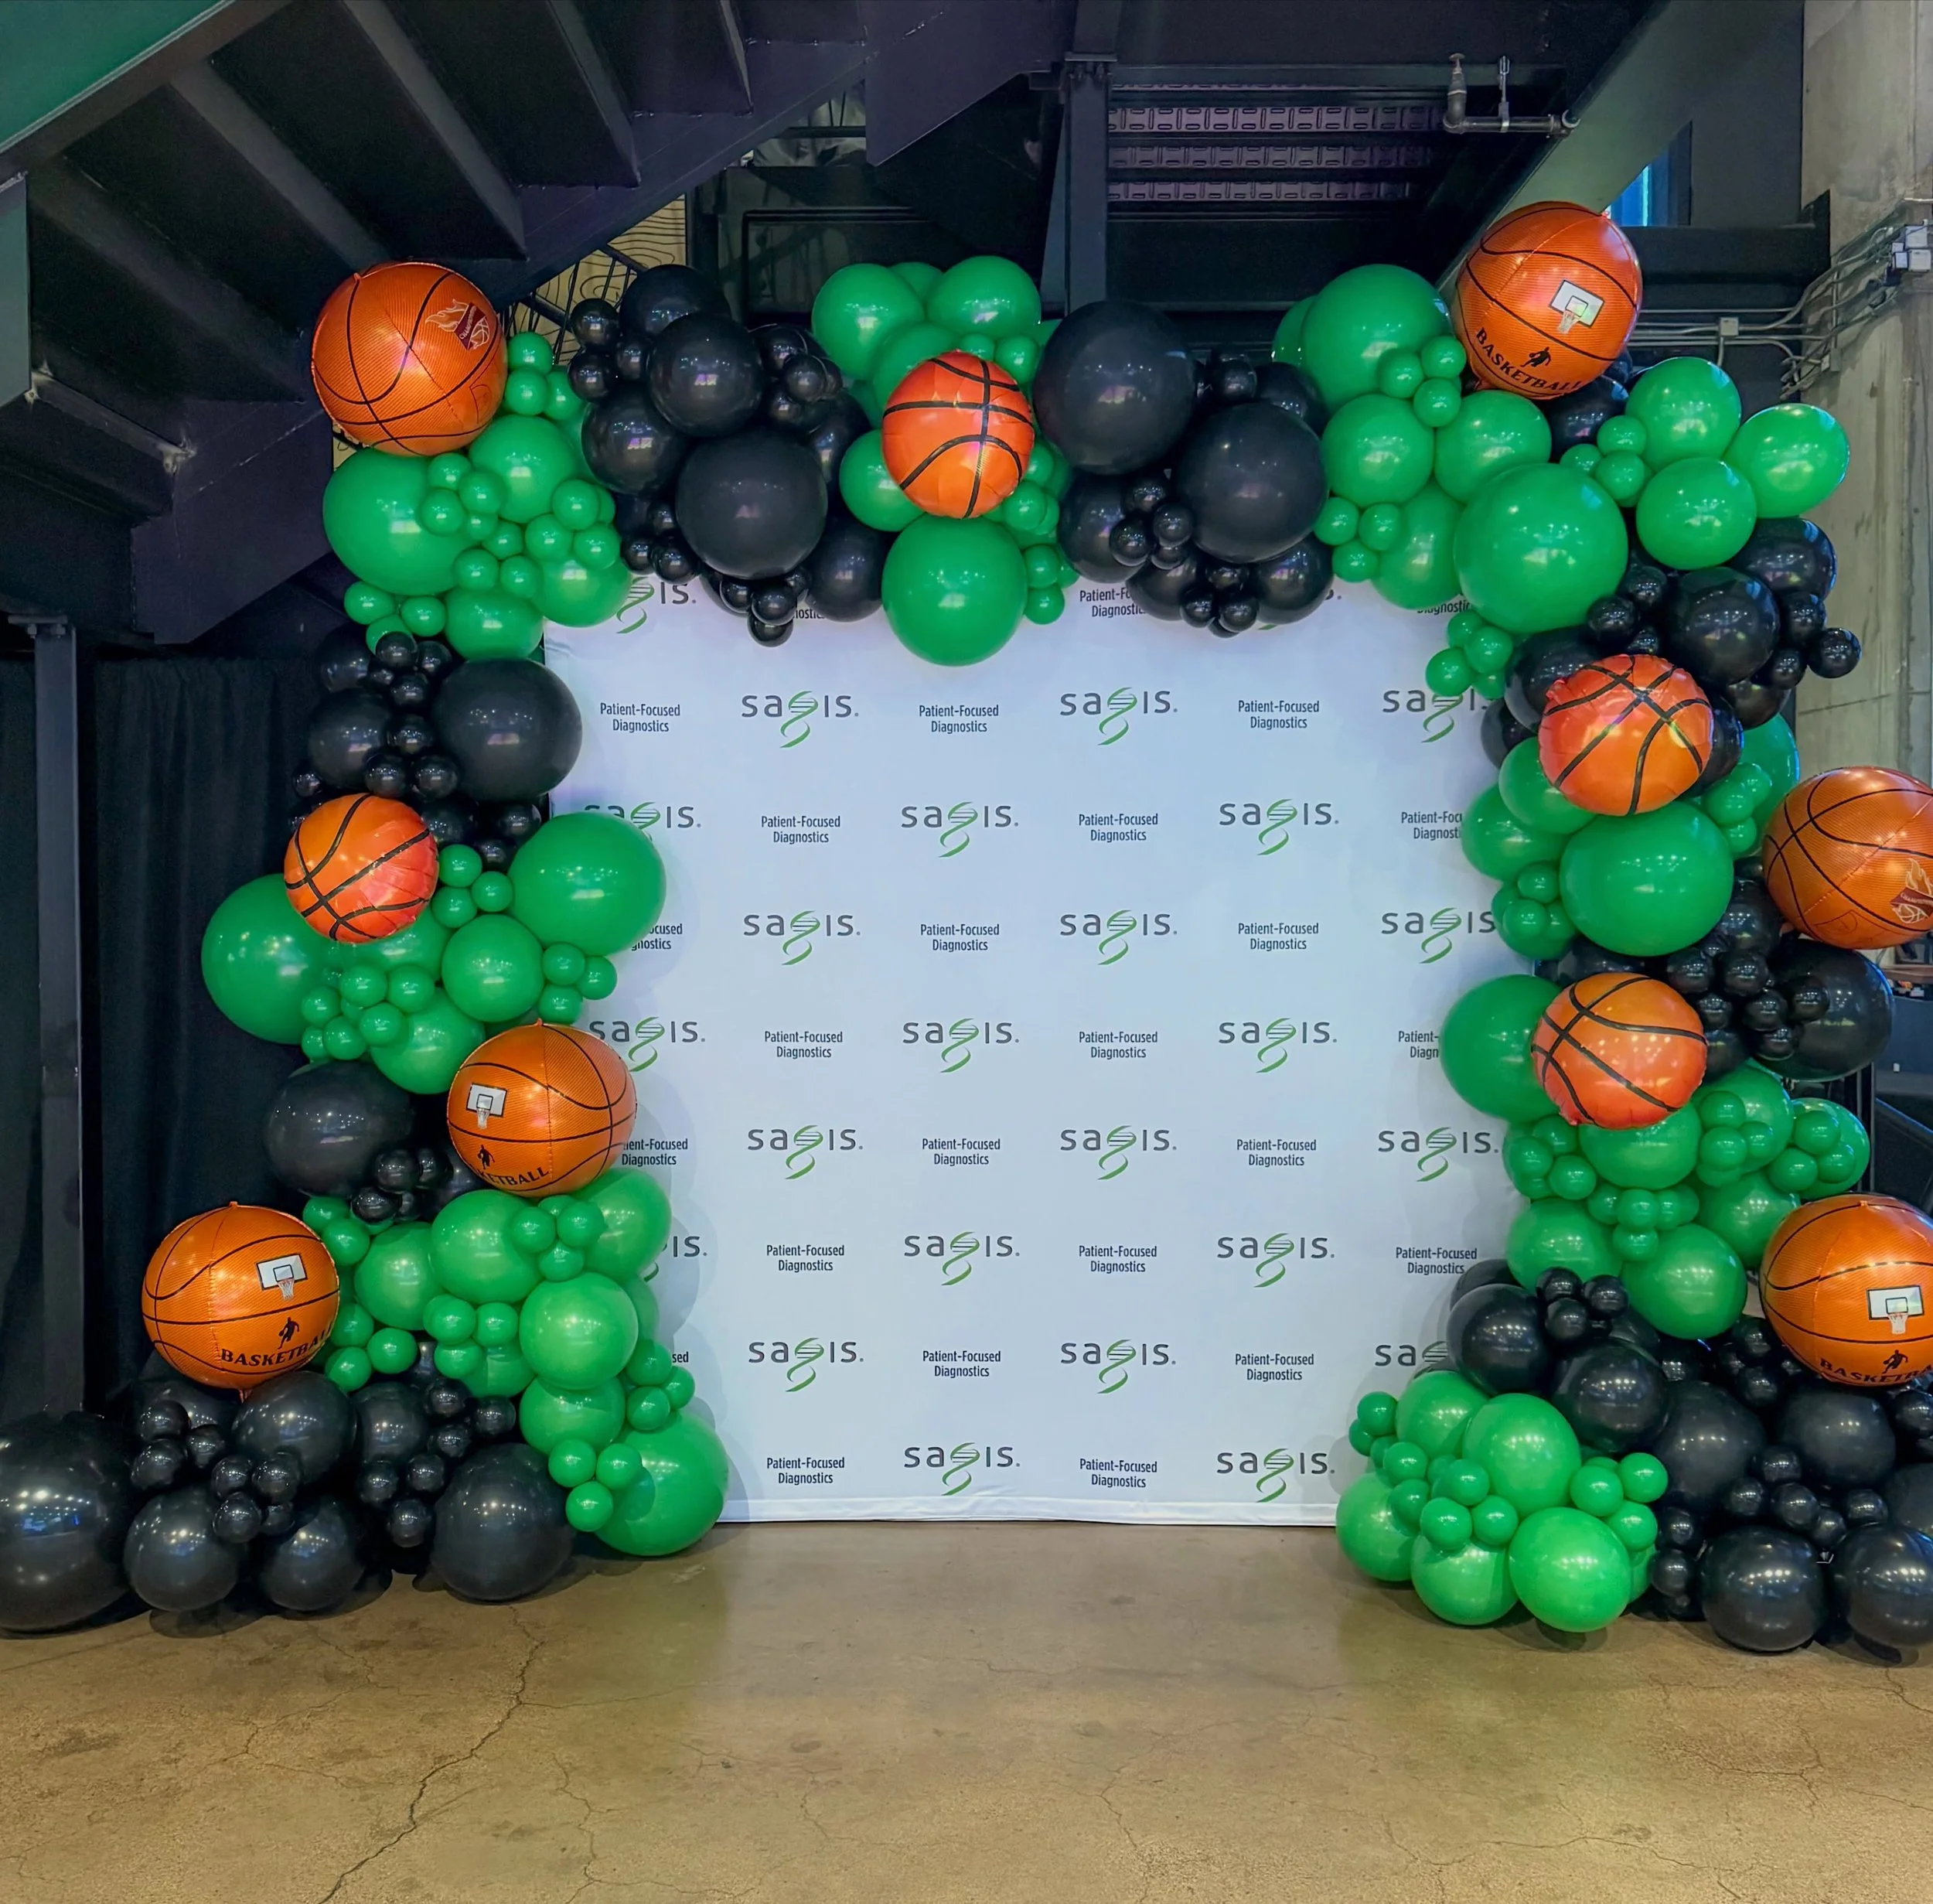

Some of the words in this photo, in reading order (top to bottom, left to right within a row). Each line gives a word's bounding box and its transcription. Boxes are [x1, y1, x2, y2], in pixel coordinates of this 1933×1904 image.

[601, 702, 680, 716] Patient-Focused
[919, 705, 998, 717] Patient-Focused
[1239, 700, 1319, 712] Patient-Focused
[613, 719, 669, 733] Diagnostics
[932, 720, 987, 734] Diagnostics
[1250, 716, 1307, 730] Diagnostics
[762, 815, 840, 827] Patient-Focused
[1079, 813, 1158, 826] Patient-Focused
[773, 831, 829, 845] Diagnostics
[1091, 829, 1147, 843] Diagnostics
[921, 923, 999, 936] Patient-Focused
[1239, 923, 1318, 934] Patient-Focused
[932, 939, 988, 952] Diagnostics
[1250, 938, 1307, 951] Diagnostics
[765, 1031, 843, 1042] Patient-Focused
[1079, 1031, 1157, 1042] Patient-Focused
[777, 1046, 831, 1059] Diagnostics
[1091, 1046, 1146, 1059] Diagnostics
[922, 1138, 1001, 1150] Patient-Focused
[1237, 1139, 1316, 1151] Patient-Focused
[622, 1154, 677, 1167] Diagnostics
[934, 1153, 989, 1166] Diagnostics
[1249, 1154, 1304, 1168] Diagnostics
[767, 1244, 844, 1256] Patient-Focused
[1079, 1245, 1157, 1257] Patient-Focused
[1396, 1247, 1477, 1259] Patient-Focused
[779, 1260, 833, 1273] Diagnostics
[1091, 1261, 1146, 1274] Diagnostics
[1407, 1262, 1464, 1275] Diagnostics
[923, 1350, 1001, 1362] Patient-Focused
[1236, 1353, 1314, 1365] Patient-Focused
[935, 1365, 990, 1378] Diagnostics
[1247, 1369, 1302, 1382] Diagnostics
[767, 1456, 844, 1469] Patient-Focused
[1080, 1458, 1157, 1472] Patient-Focused
[779, 1472, 833, 1486] Diagnostics
[1092, 1474, 1146, 1488] Diagnostics
